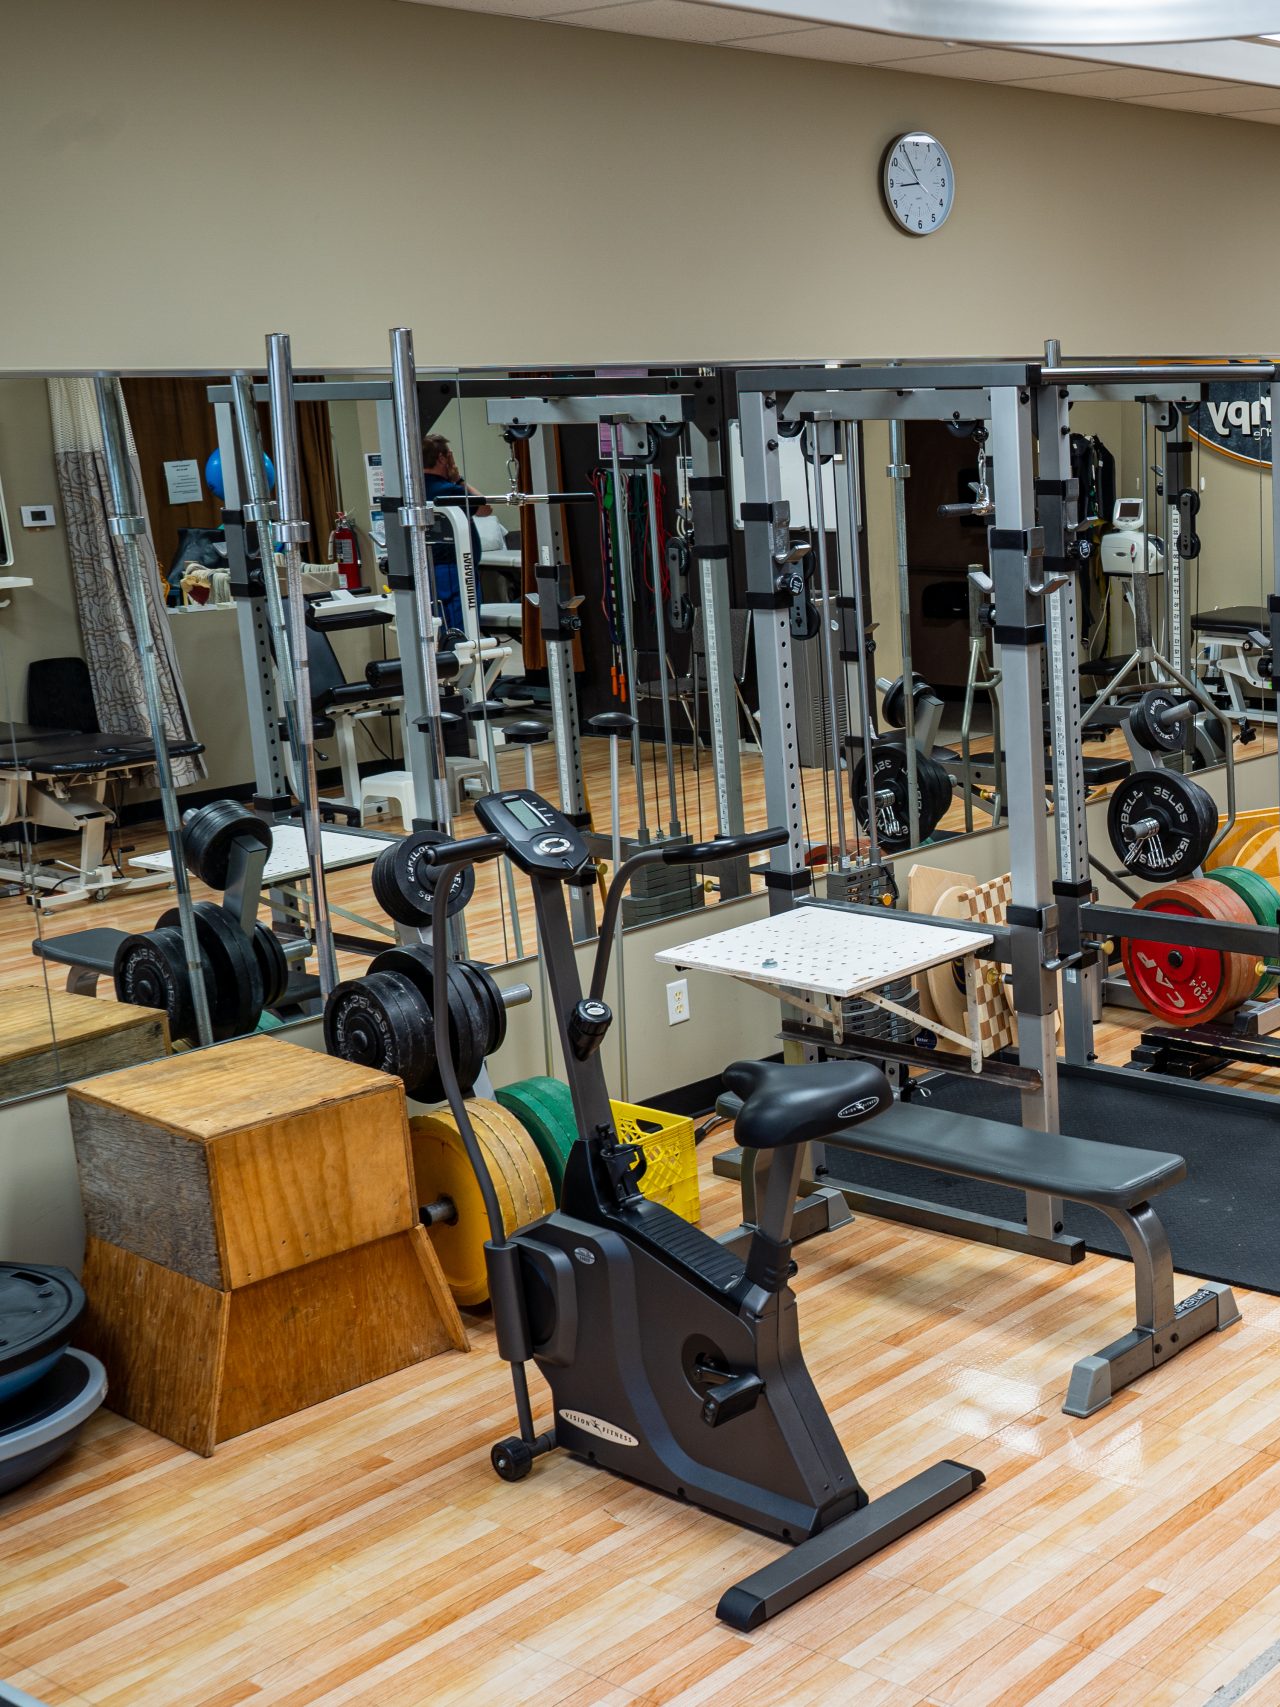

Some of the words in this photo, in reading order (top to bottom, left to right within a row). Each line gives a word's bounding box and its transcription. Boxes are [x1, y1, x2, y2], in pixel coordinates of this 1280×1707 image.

[926, 144, 931, 152] 1
[936, 158, 942, 166] 2
[890, 178, 894, 188] 9
[940, 178, 946, 187] 3
[939, 199, 944, 207] 4
[904, 214, 909, 223] 7
[931, 214, 936, 223] 5
[918, 220, 923, 229] 6
[1154, 786, 1188, 823] 35LBS
[1137, 952, 1185, 1008] CAP
[351, 995, 388, 1032] 25LBS
[565, 1412, 590, 1426] VISION
[602, 1427, 632, 1443] FITNESS
